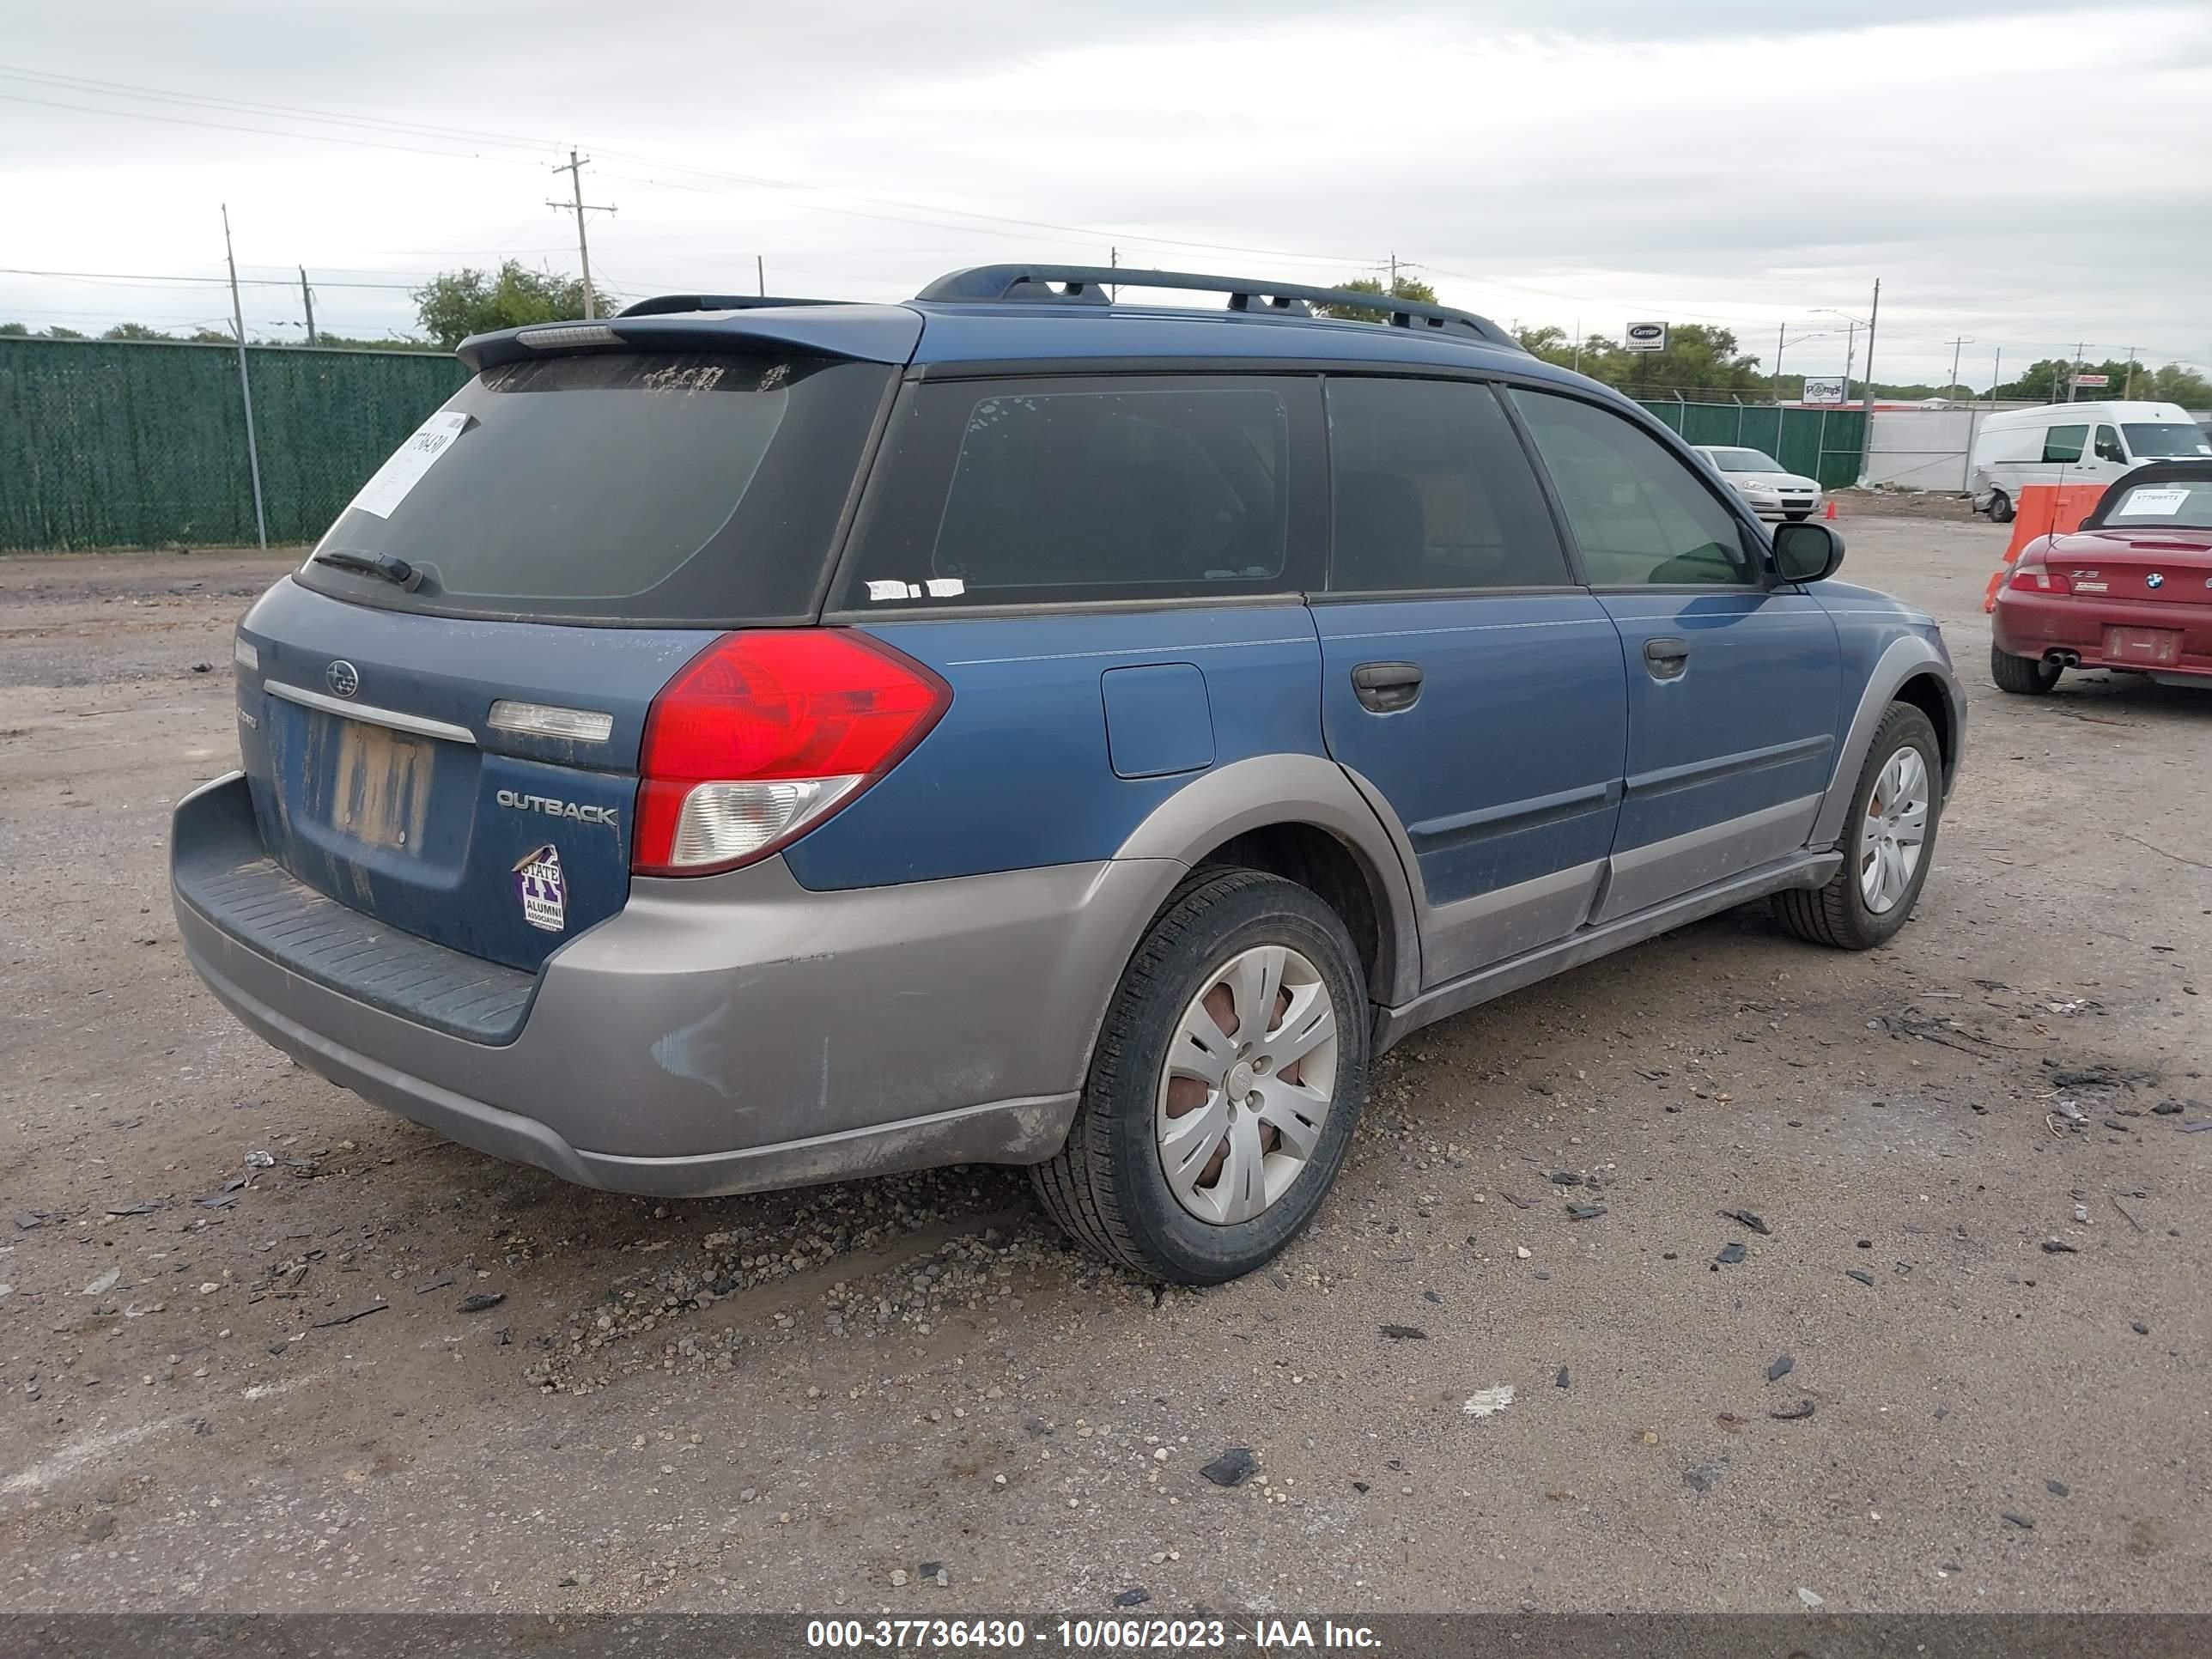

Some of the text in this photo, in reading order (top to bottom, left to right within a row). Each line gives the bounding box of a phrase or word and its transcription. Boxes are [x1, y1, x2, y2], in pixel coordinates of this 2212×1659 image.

[2070, 570, 2100, 579] Z3
[496, 789, 618, 827] OUTBACK
[526, 899, 562, 919] ALUMNI
[527, 912, 563, 927] ASSOCIATION
